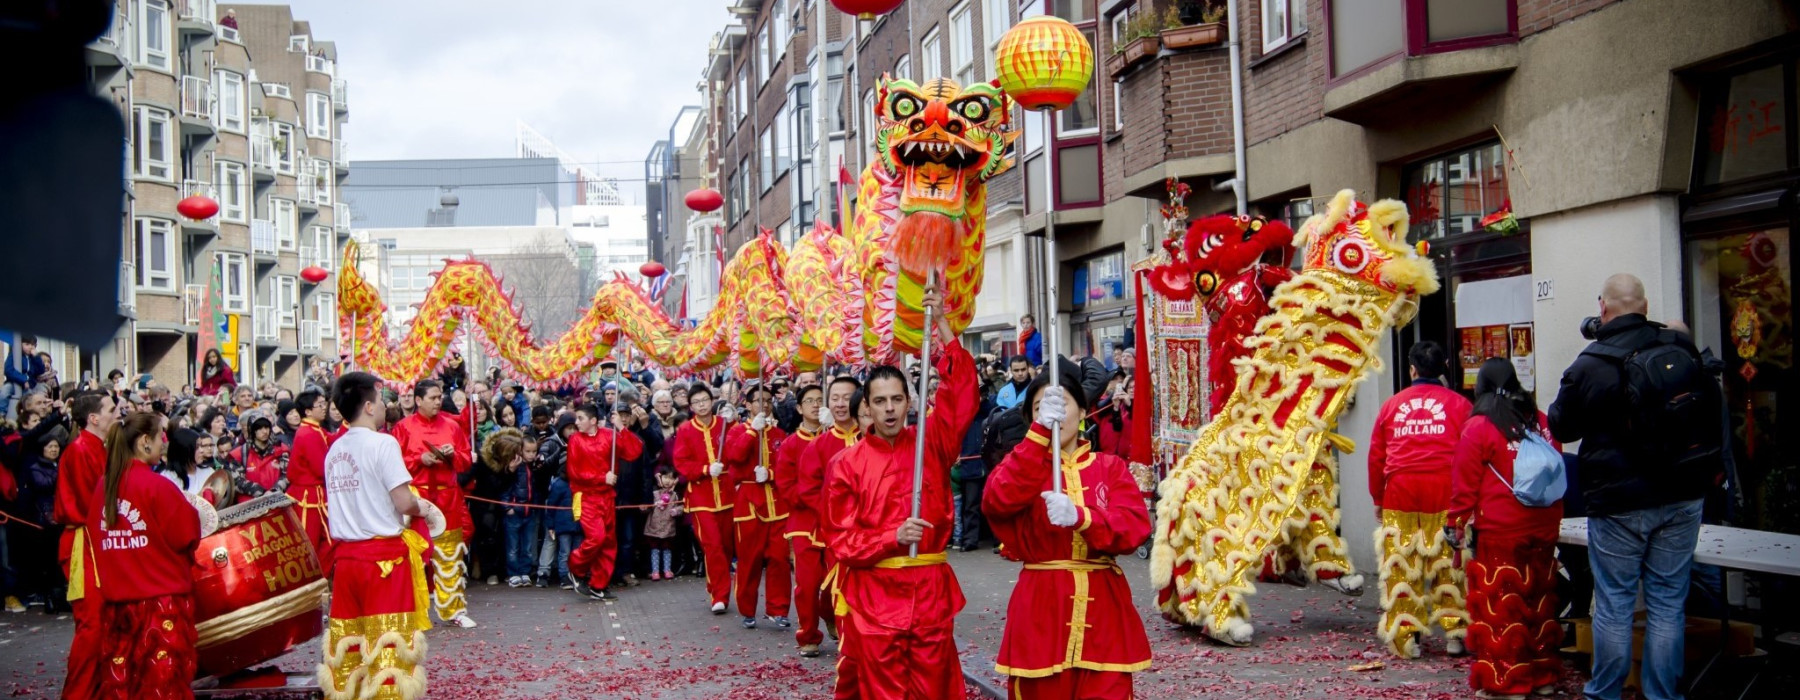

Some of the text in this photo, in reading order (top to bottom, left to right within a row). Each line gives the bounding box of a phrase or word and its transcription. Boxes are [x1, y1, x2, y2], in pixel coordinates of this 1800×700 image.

[1394, 424, 1446, 438] HOLLAND
[239, 515, 288, 547] YAT
[243, 535, 293, 564] DRAGON
